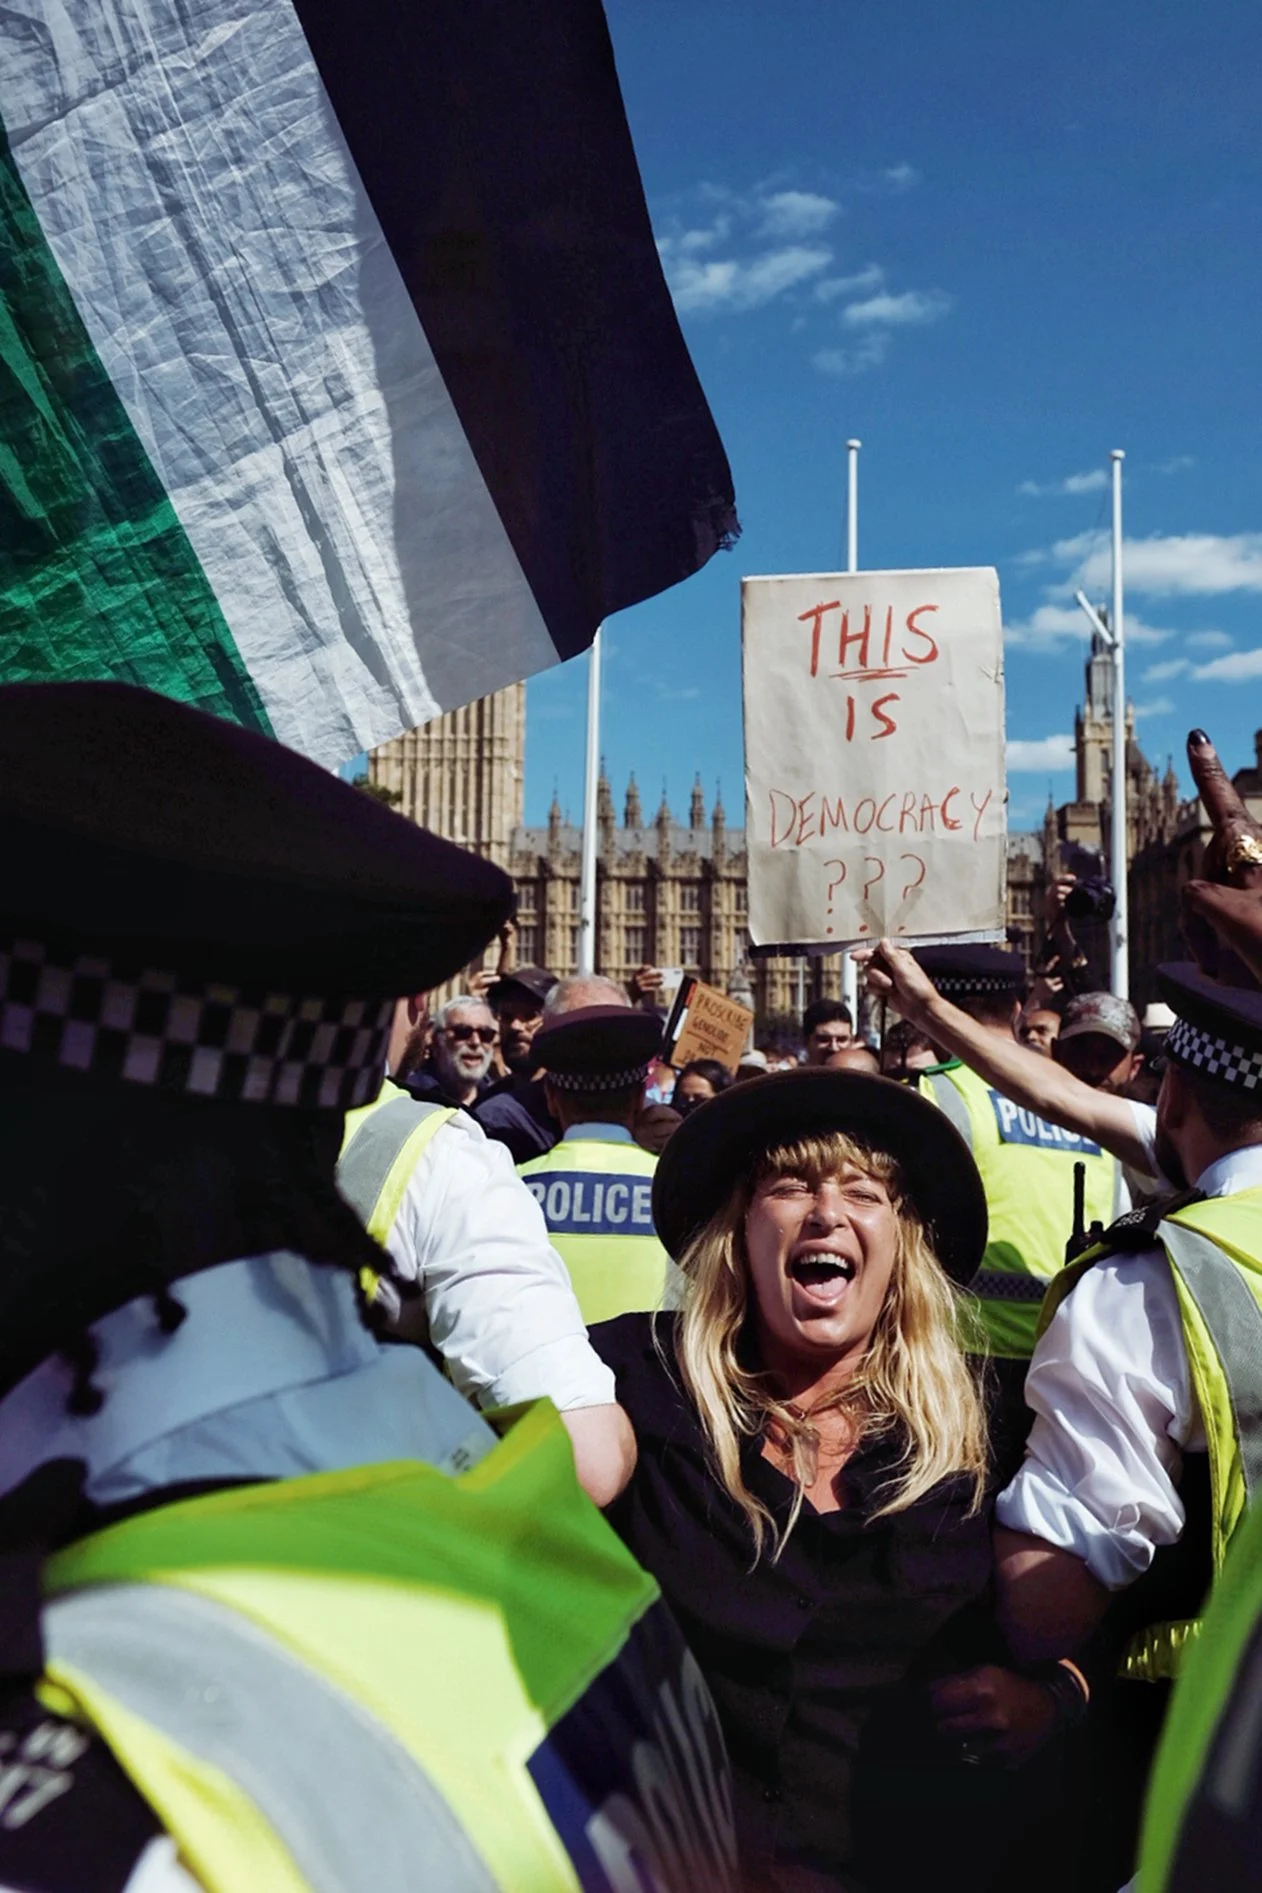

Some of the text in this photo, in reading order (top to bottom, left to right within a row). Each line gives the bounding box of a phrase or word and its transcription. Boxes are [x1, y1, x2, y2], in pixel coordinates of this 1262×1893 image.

[798, 600, 939, 677] THIS
[845, 693, 900, 741] IS
[769, 786, 993, 848] DEMOCRACY
[996, 1098, 1096, 1145] POL
